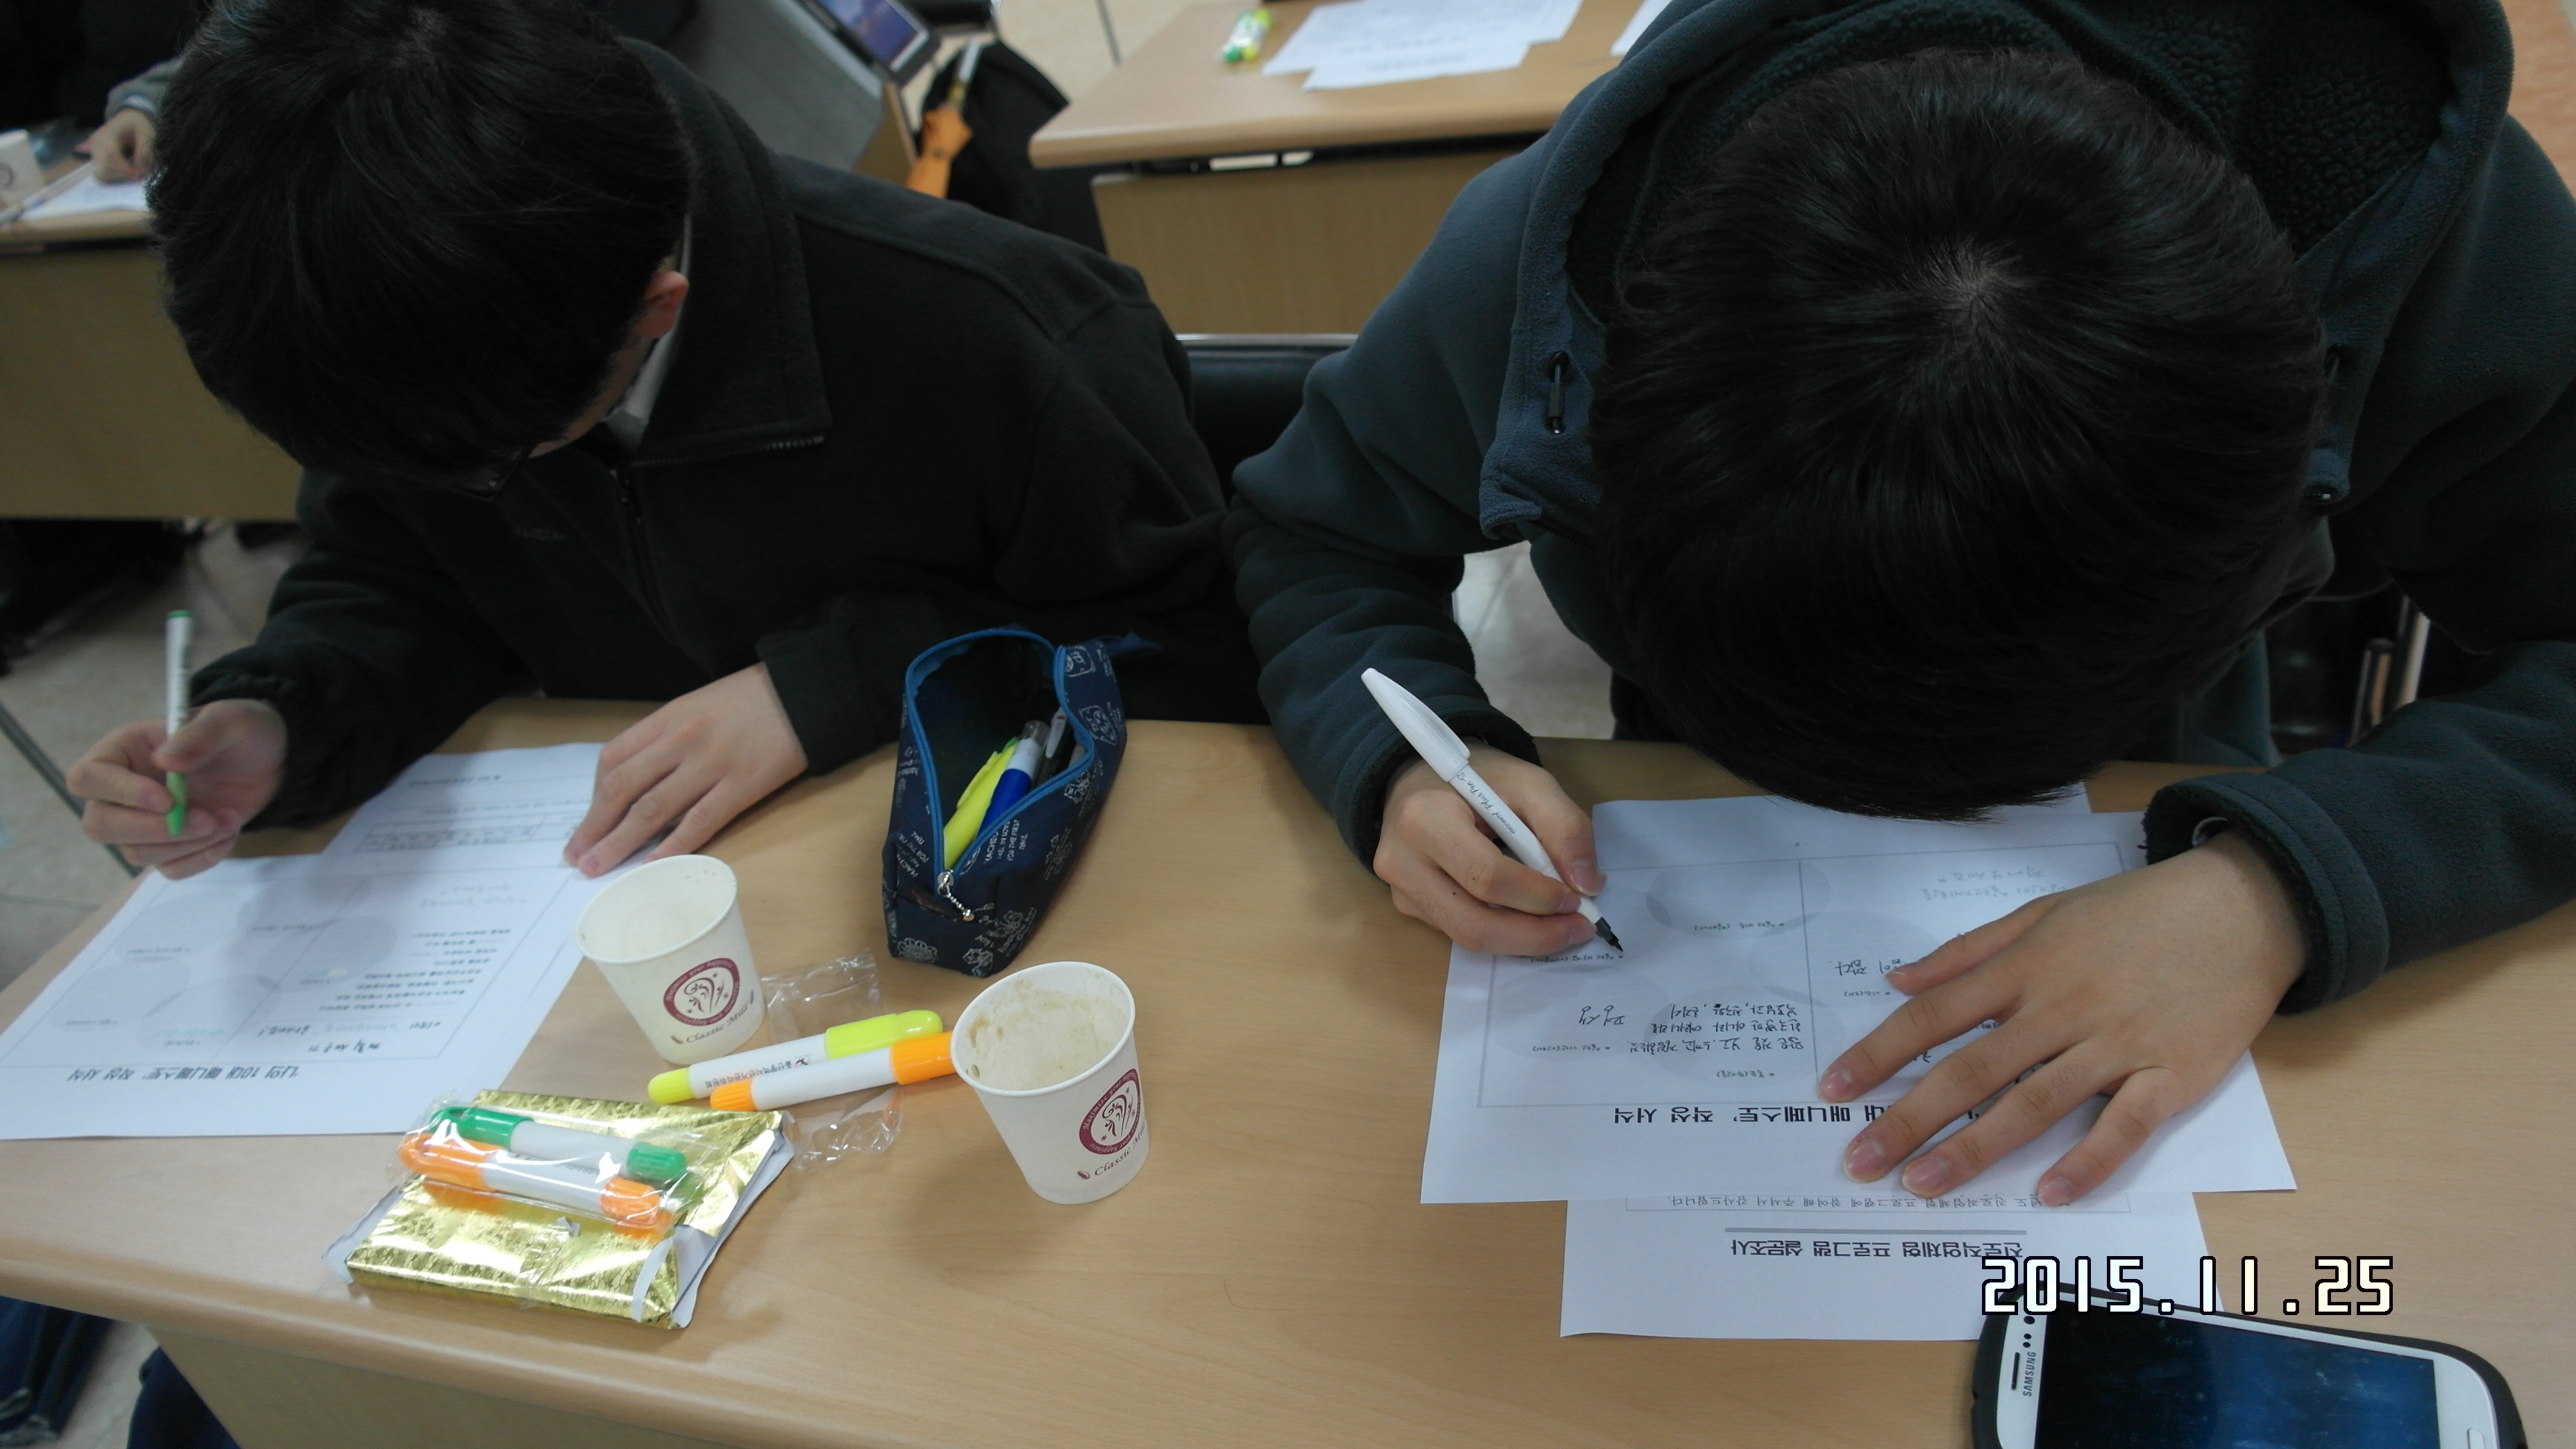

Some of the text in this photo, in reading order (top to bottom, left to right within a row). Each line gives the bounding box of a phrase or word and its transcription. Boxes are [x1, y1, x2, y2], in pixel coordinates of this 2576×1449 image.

[1477, 792, 1494, 811] Plus
[1578, 1005, 1625, 1026] 평생
[686, 1023, 724, 1044] Classic
[1713, 1021, 1745, 1033] 아니라
[1752, 1037, 1772, 1051] 것을
[1083, 1094, 1108, 1130] Maximize
[1613, 1108, 1658, 1124] 서식
[1670, 1107, 1713, 1124] 작성
[1094, 1147, 1131, 1176] Classic
[1667, 1196, 1747, 1207] 감사드립니다.
[1756, 1196, 1795, 1207] 주셔서
[1803, 1197, 1839, 1208] 참여해
[1850, 1197, 1916, 1208] 프로그램에
[1925, 1197, 2006, 1208] 진로직업체험
[1731, 1240, 2023, 1258] 진로직업체험 프로그램 설문조사
[2022, 1350, 2036, 1398] SAMSUNG
